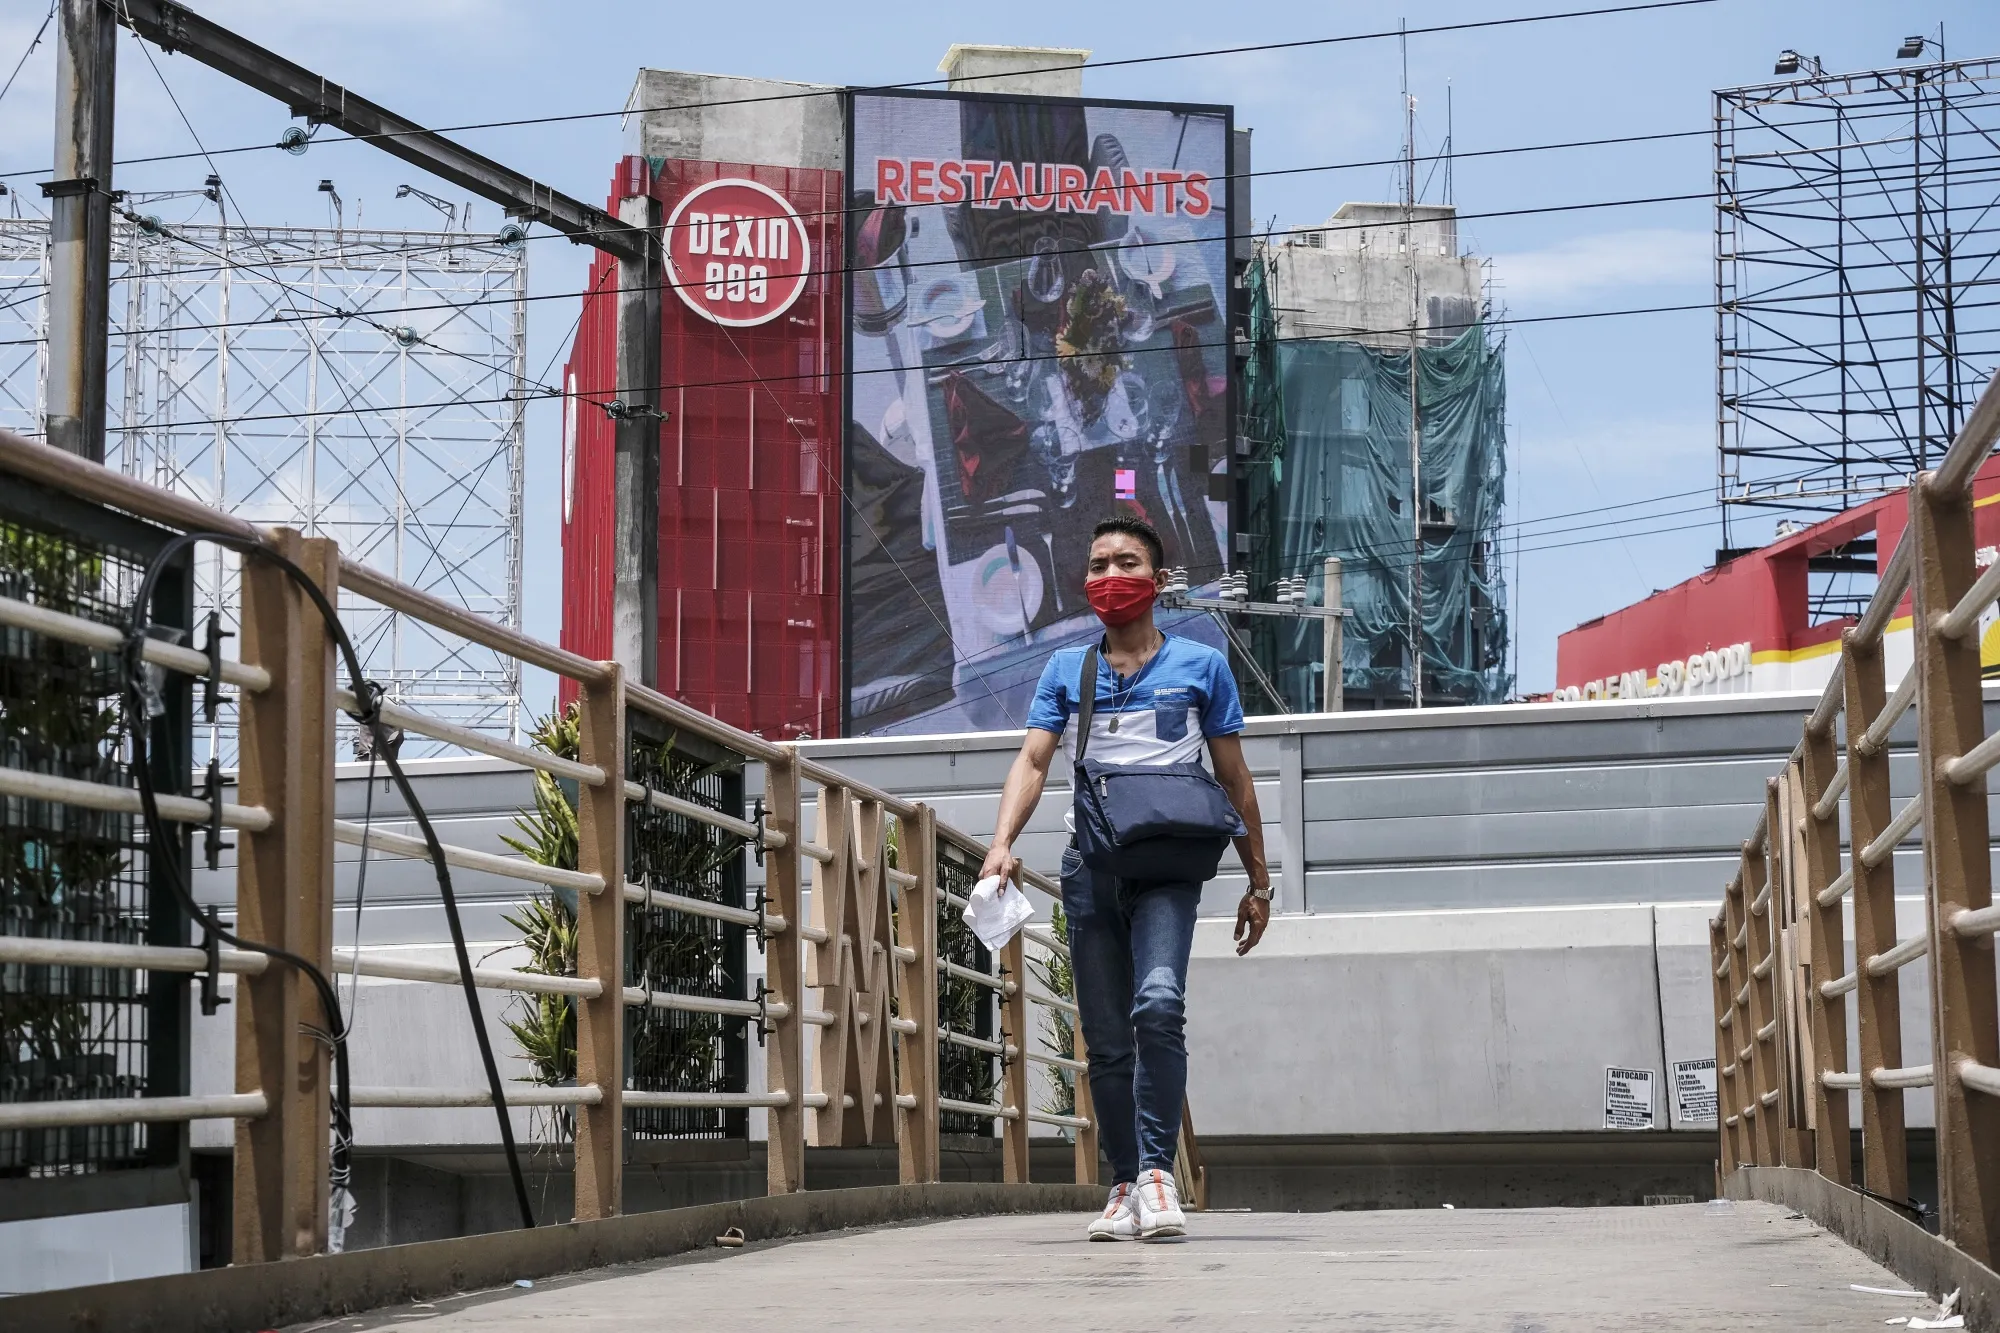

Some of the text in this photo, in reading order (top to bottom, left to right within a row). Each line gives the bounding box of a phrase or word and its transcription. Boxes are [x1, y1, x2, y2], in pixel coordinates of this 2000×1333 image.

[874, 157, 1214, 218] RESTAURANTS
[689, 212, 789, 259] DEXIN
[705, 262, 767, 303] 999
